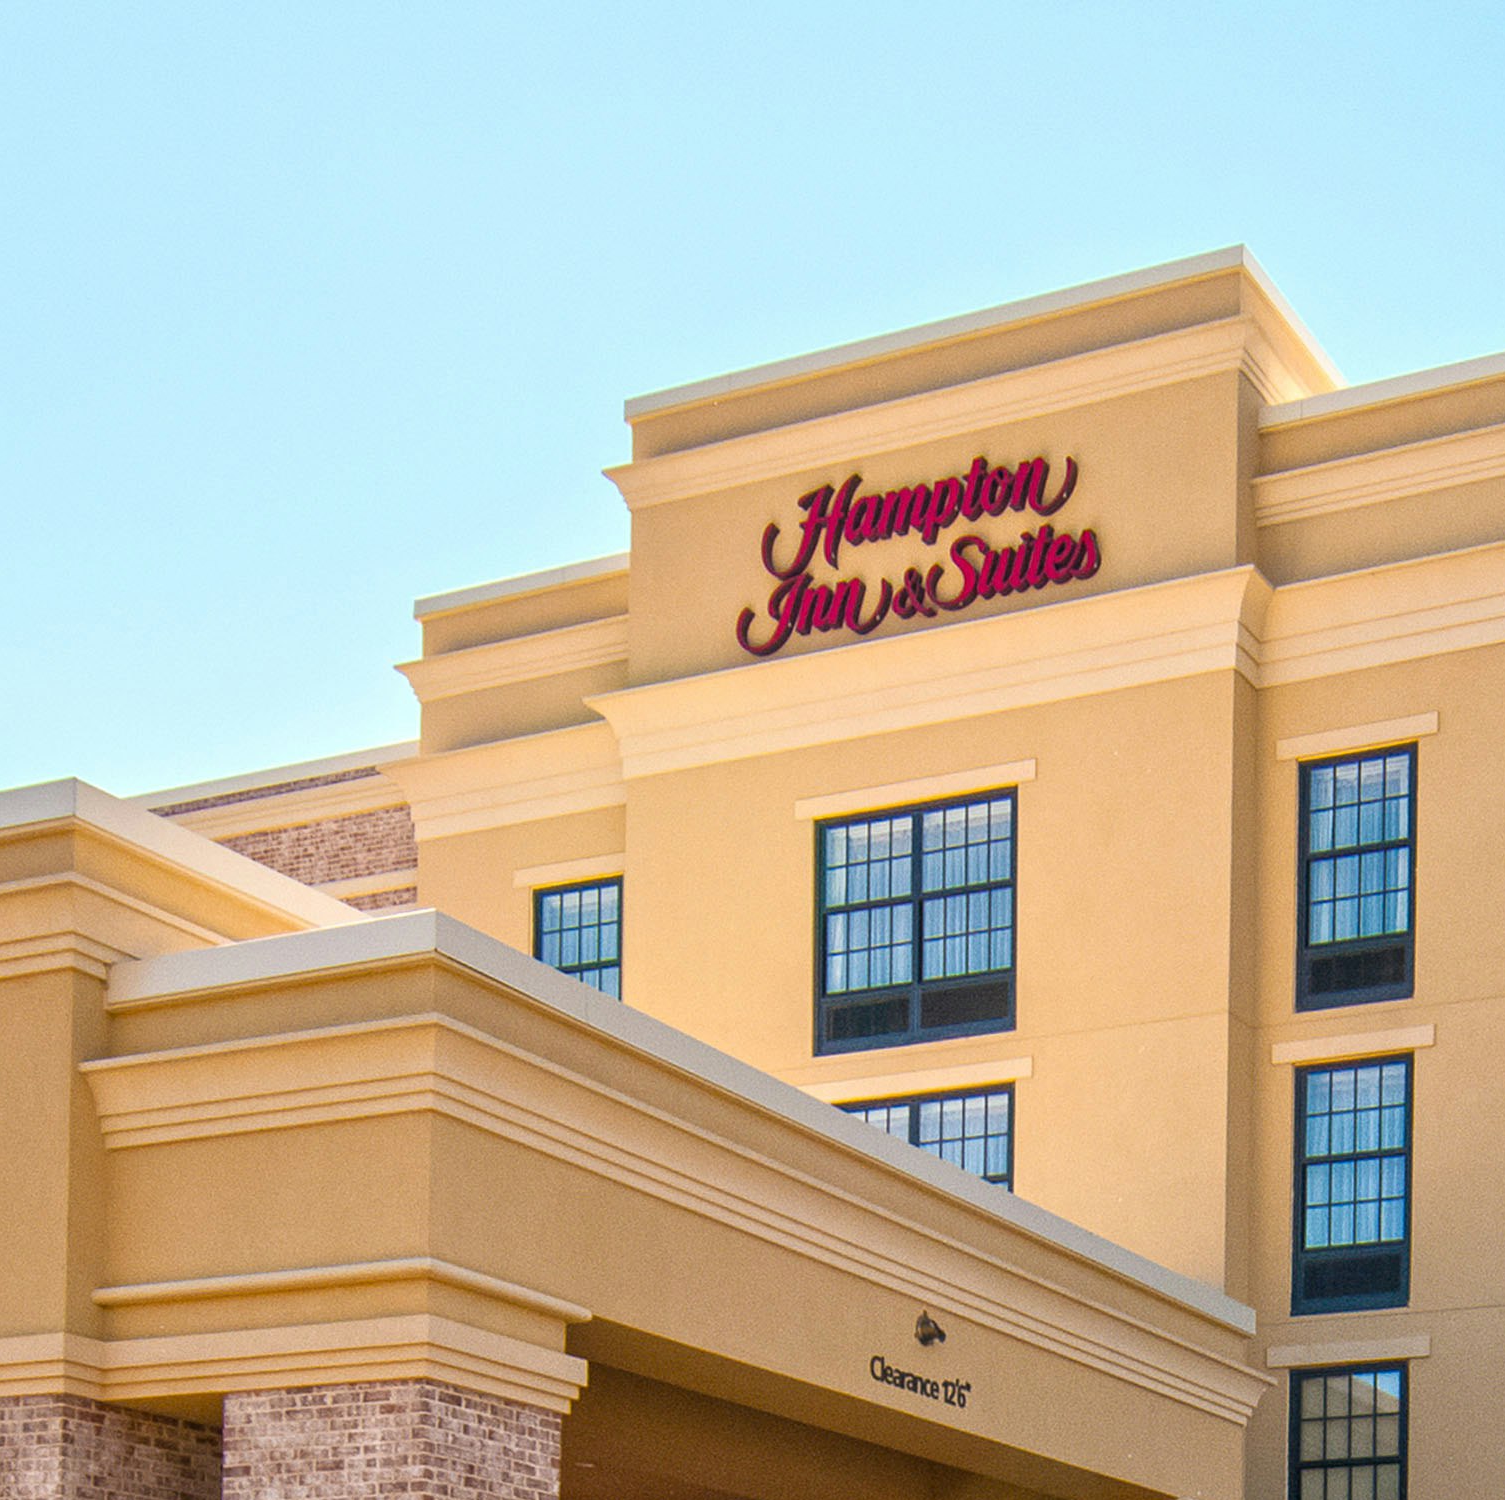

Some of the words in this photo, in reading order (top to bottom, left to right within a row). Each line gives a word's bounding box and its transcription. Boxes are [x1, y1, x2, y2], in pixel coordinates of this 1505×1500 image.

[761, 455, 1078, 580] Hampton
[736, 572, 893, 657] Inn
[893, 566, 938, 619] &
[926, 523, 1102, 611] Suites
[869, 1355, 940, 1400] Clearance
